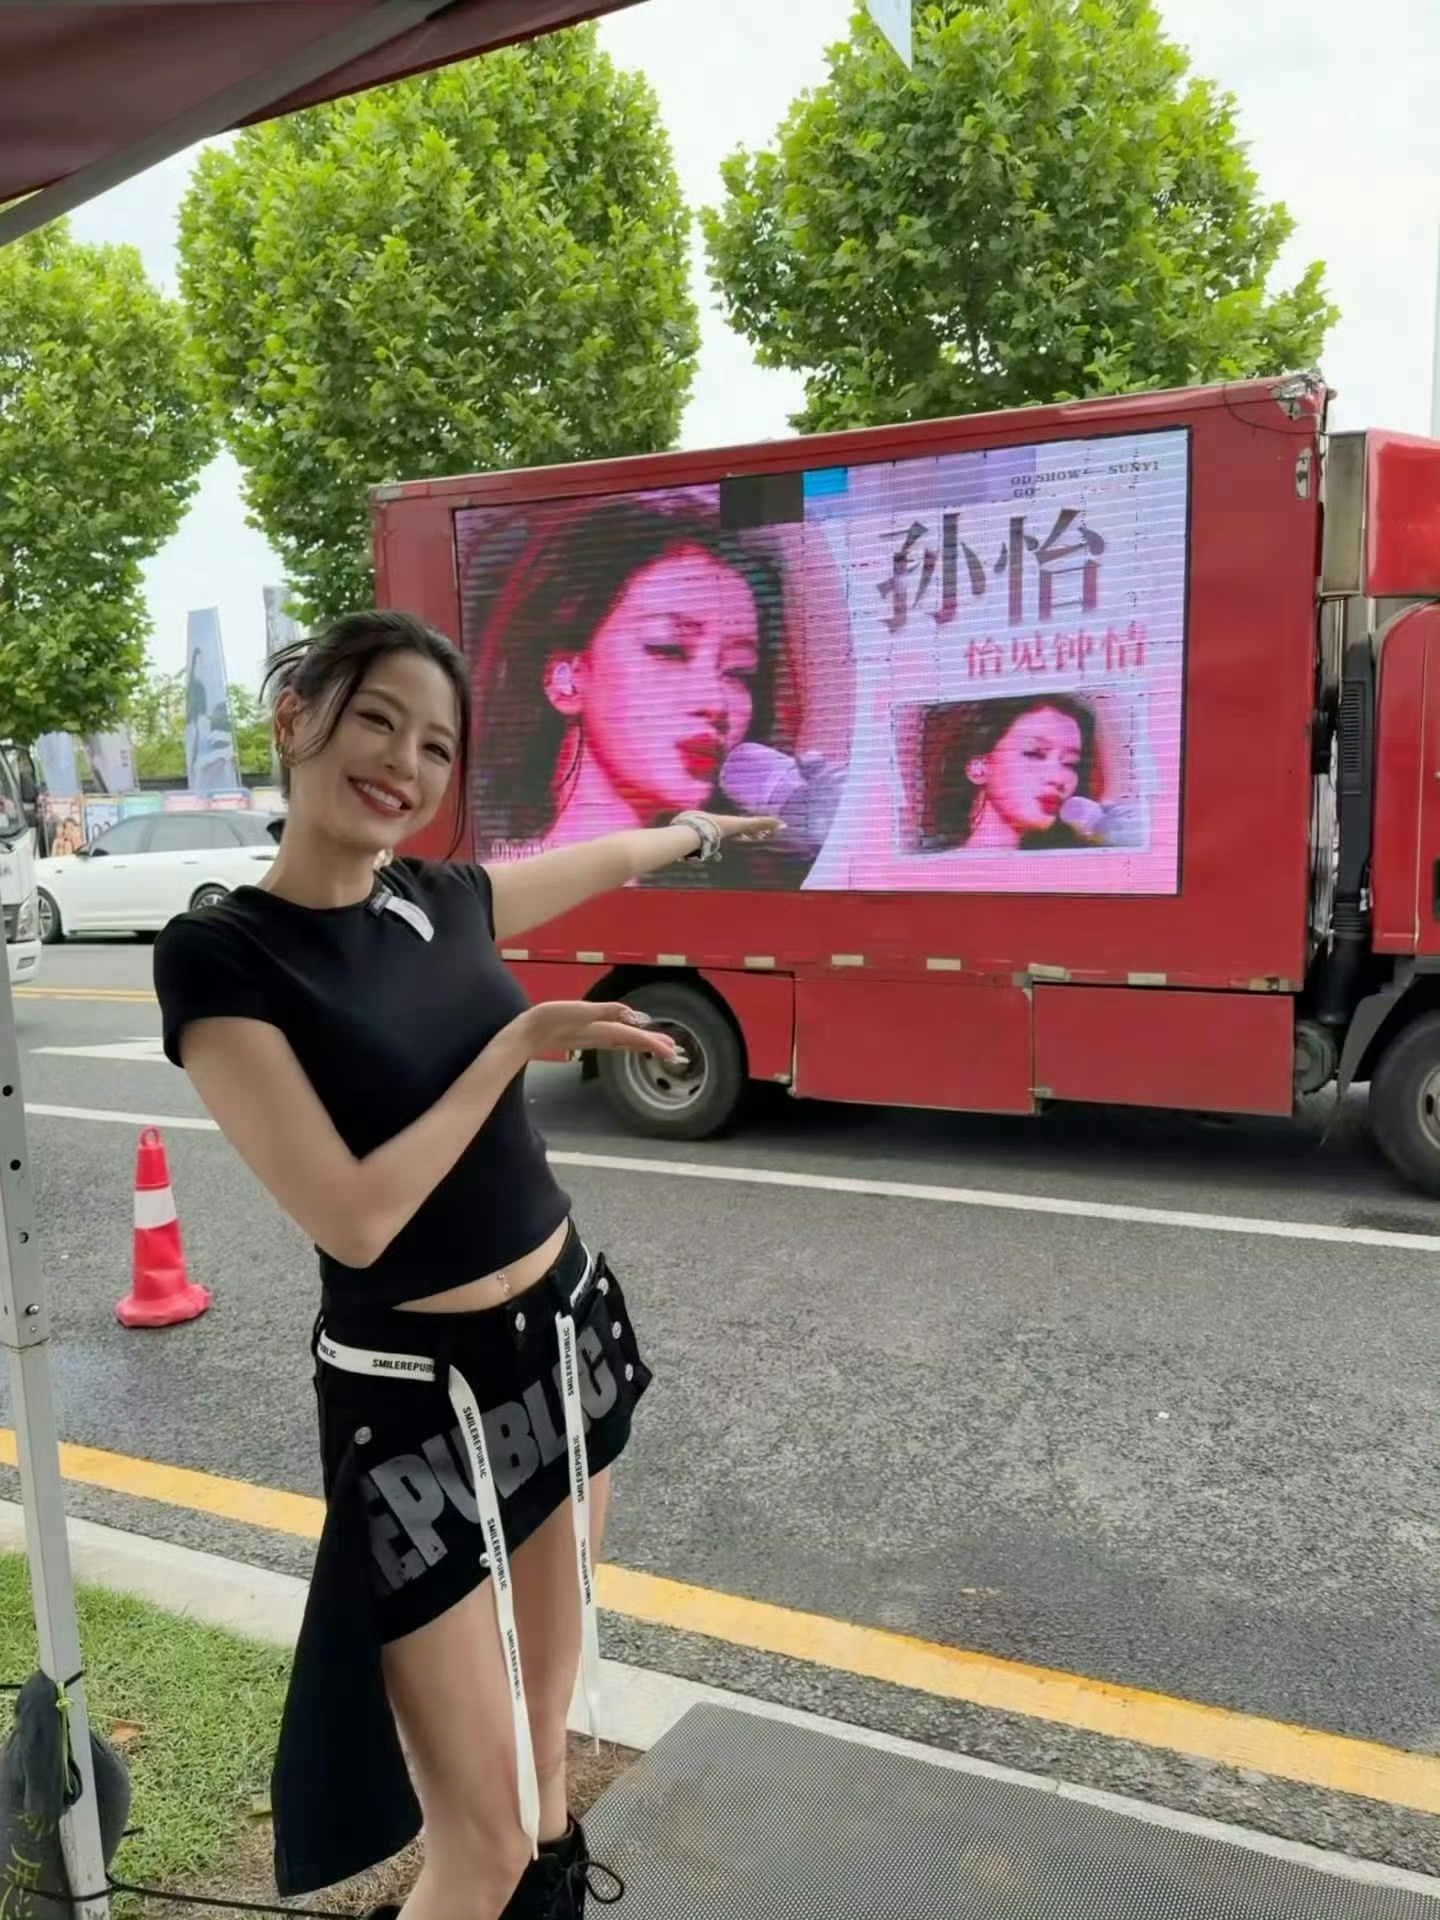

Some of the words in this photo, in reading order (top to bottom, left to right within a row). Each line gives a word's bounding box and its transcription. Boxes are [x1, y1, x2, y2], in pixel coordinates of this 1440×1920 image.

[1108, 461, 1159, 475] SUNYI
[876, 508, 1106, 635] 孙怡
[965, 621, 1147, 677] 怡见钟情
[562, 1326, 575, 1397] SMILEREPUBLIC
[462, 1406, 488, 1480] SMILEREPUBLIC
[573, 1434, 585, 1503] SMILEREPUBLIC
[487, 1517, 508, 1592] SMILEREPUBLIC
